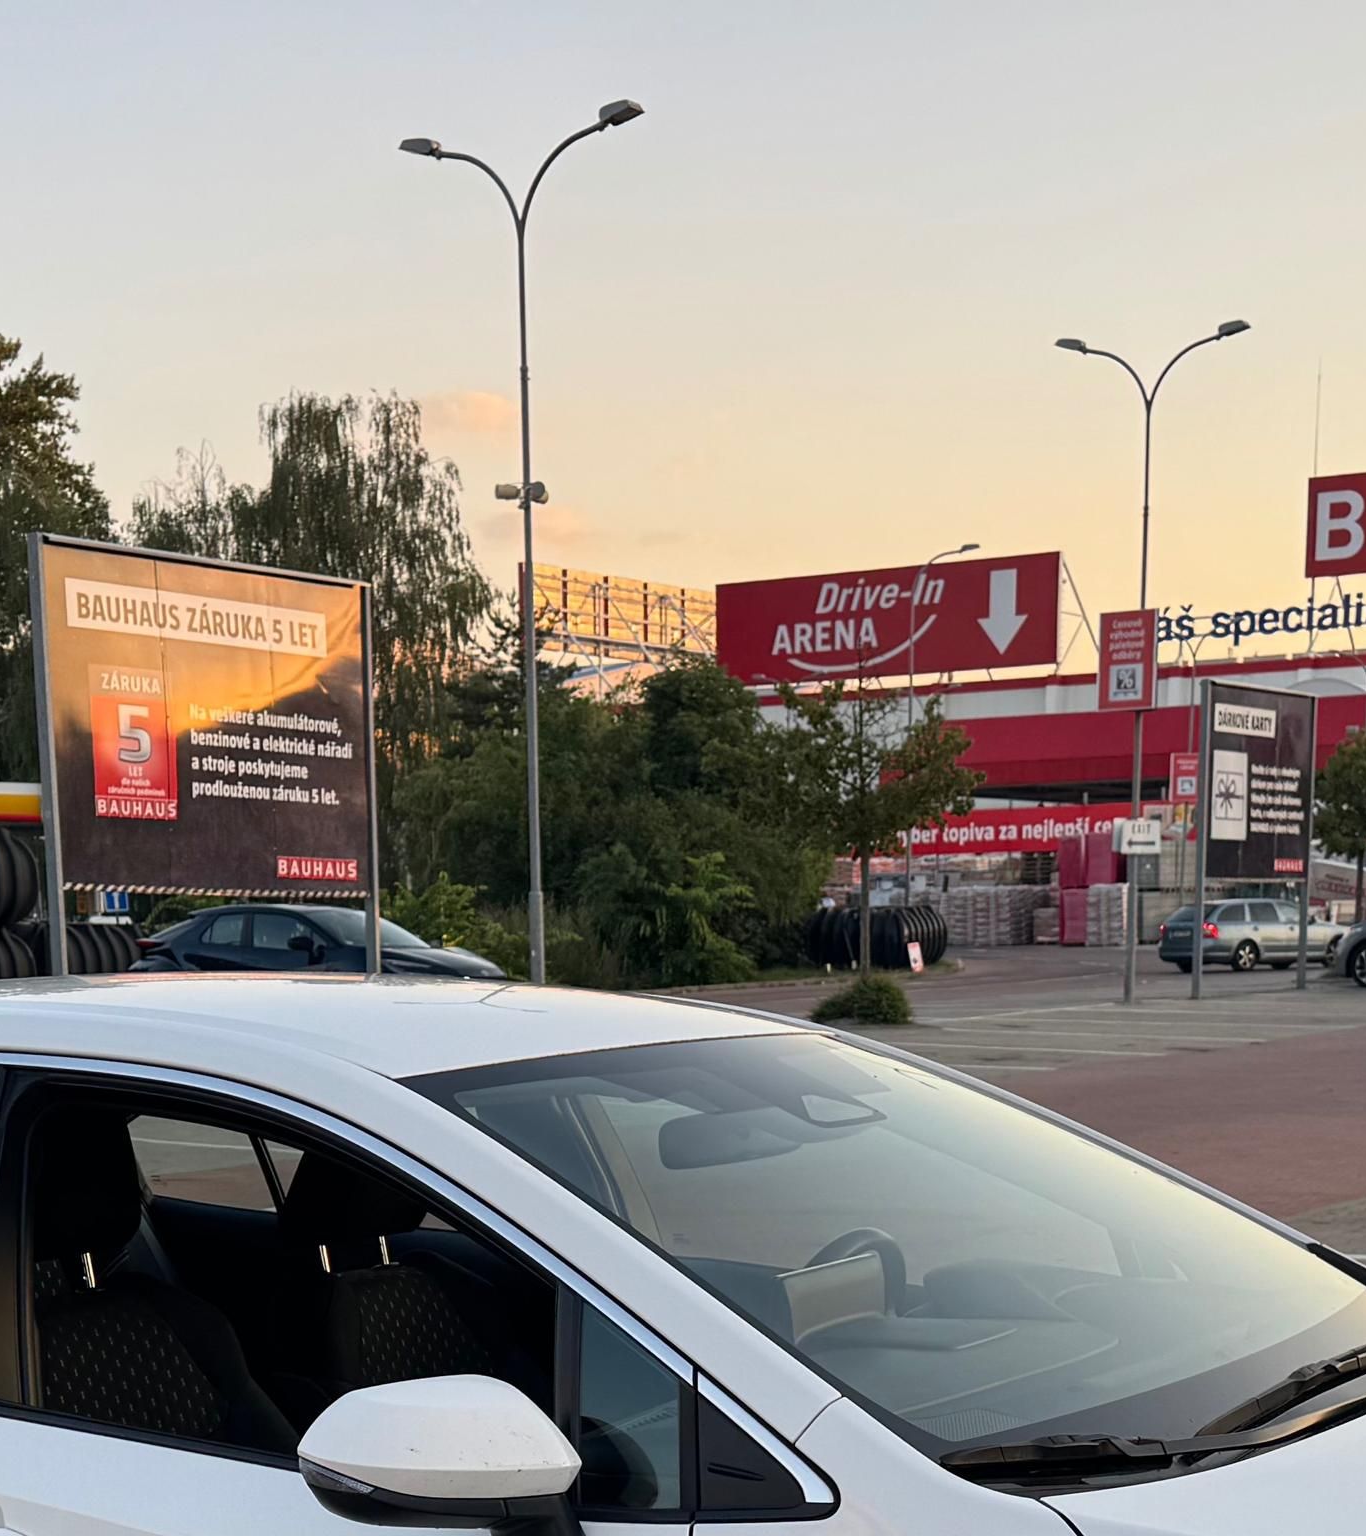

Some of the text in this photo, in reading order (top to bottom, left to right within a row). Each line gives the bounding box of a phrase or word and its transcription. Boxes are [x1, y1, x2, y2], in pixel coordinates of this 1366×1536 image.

[815, 573, 945, 614] Drive-In
[76, 591, 318, 649] BAUHAUS ZÁRUKA 5 LET
[1157, 603, 1194, 643] áš
[771, 617, 879, 655] ARENA
[101, 671, 161, 693] ZÁRUKA
[117, 703, 152, 763] 5
[189, 704, 342, 737] Na veškeré akumulátorové,
[190, 729, 251, 750] benzinové
[252, 737, 260, 750] a
[262, 735, 315, 756] elektrické
[191, 755, 309, 780] a stroje poskytujeme
[192, 780, 340, 805] prodlouženou záruku 5 let.
[97, 798, 177, 818] BAUHAUS
[998, 824, 1017, 841] za
[1021, 817, 1090, 843] nejlepší
[277, 859, 357, 878] BAUHAUS
